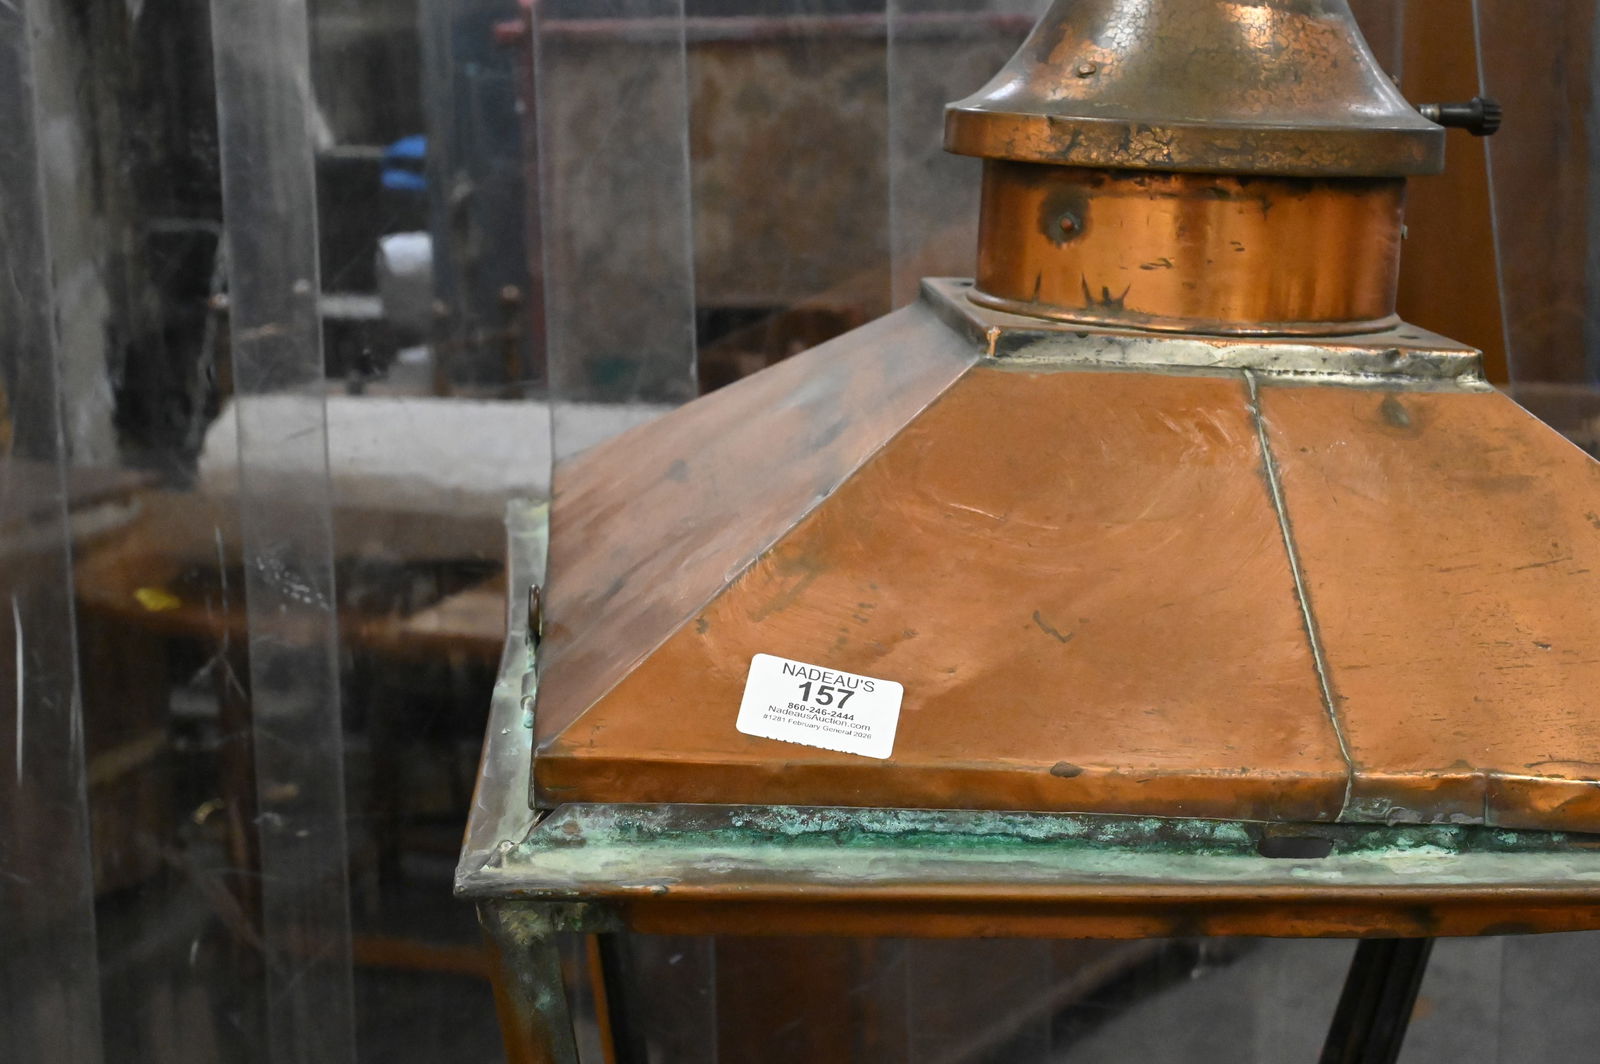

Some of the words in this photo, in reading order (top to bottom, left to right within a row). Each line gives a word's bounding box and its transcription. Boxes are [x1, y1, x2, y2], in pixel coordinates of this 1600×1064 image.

[782, 662, 875, 692] NADEAU'S
[798, 681, 855, 709] 157
[762, 713, 786, 723] #1281
[788, 718, 820, 731] February
[822, 725, 852, 736] General
[768, 705, 871, 731] NadeausAuction.com
[787, 702, 855, 721] 860-246-2444
